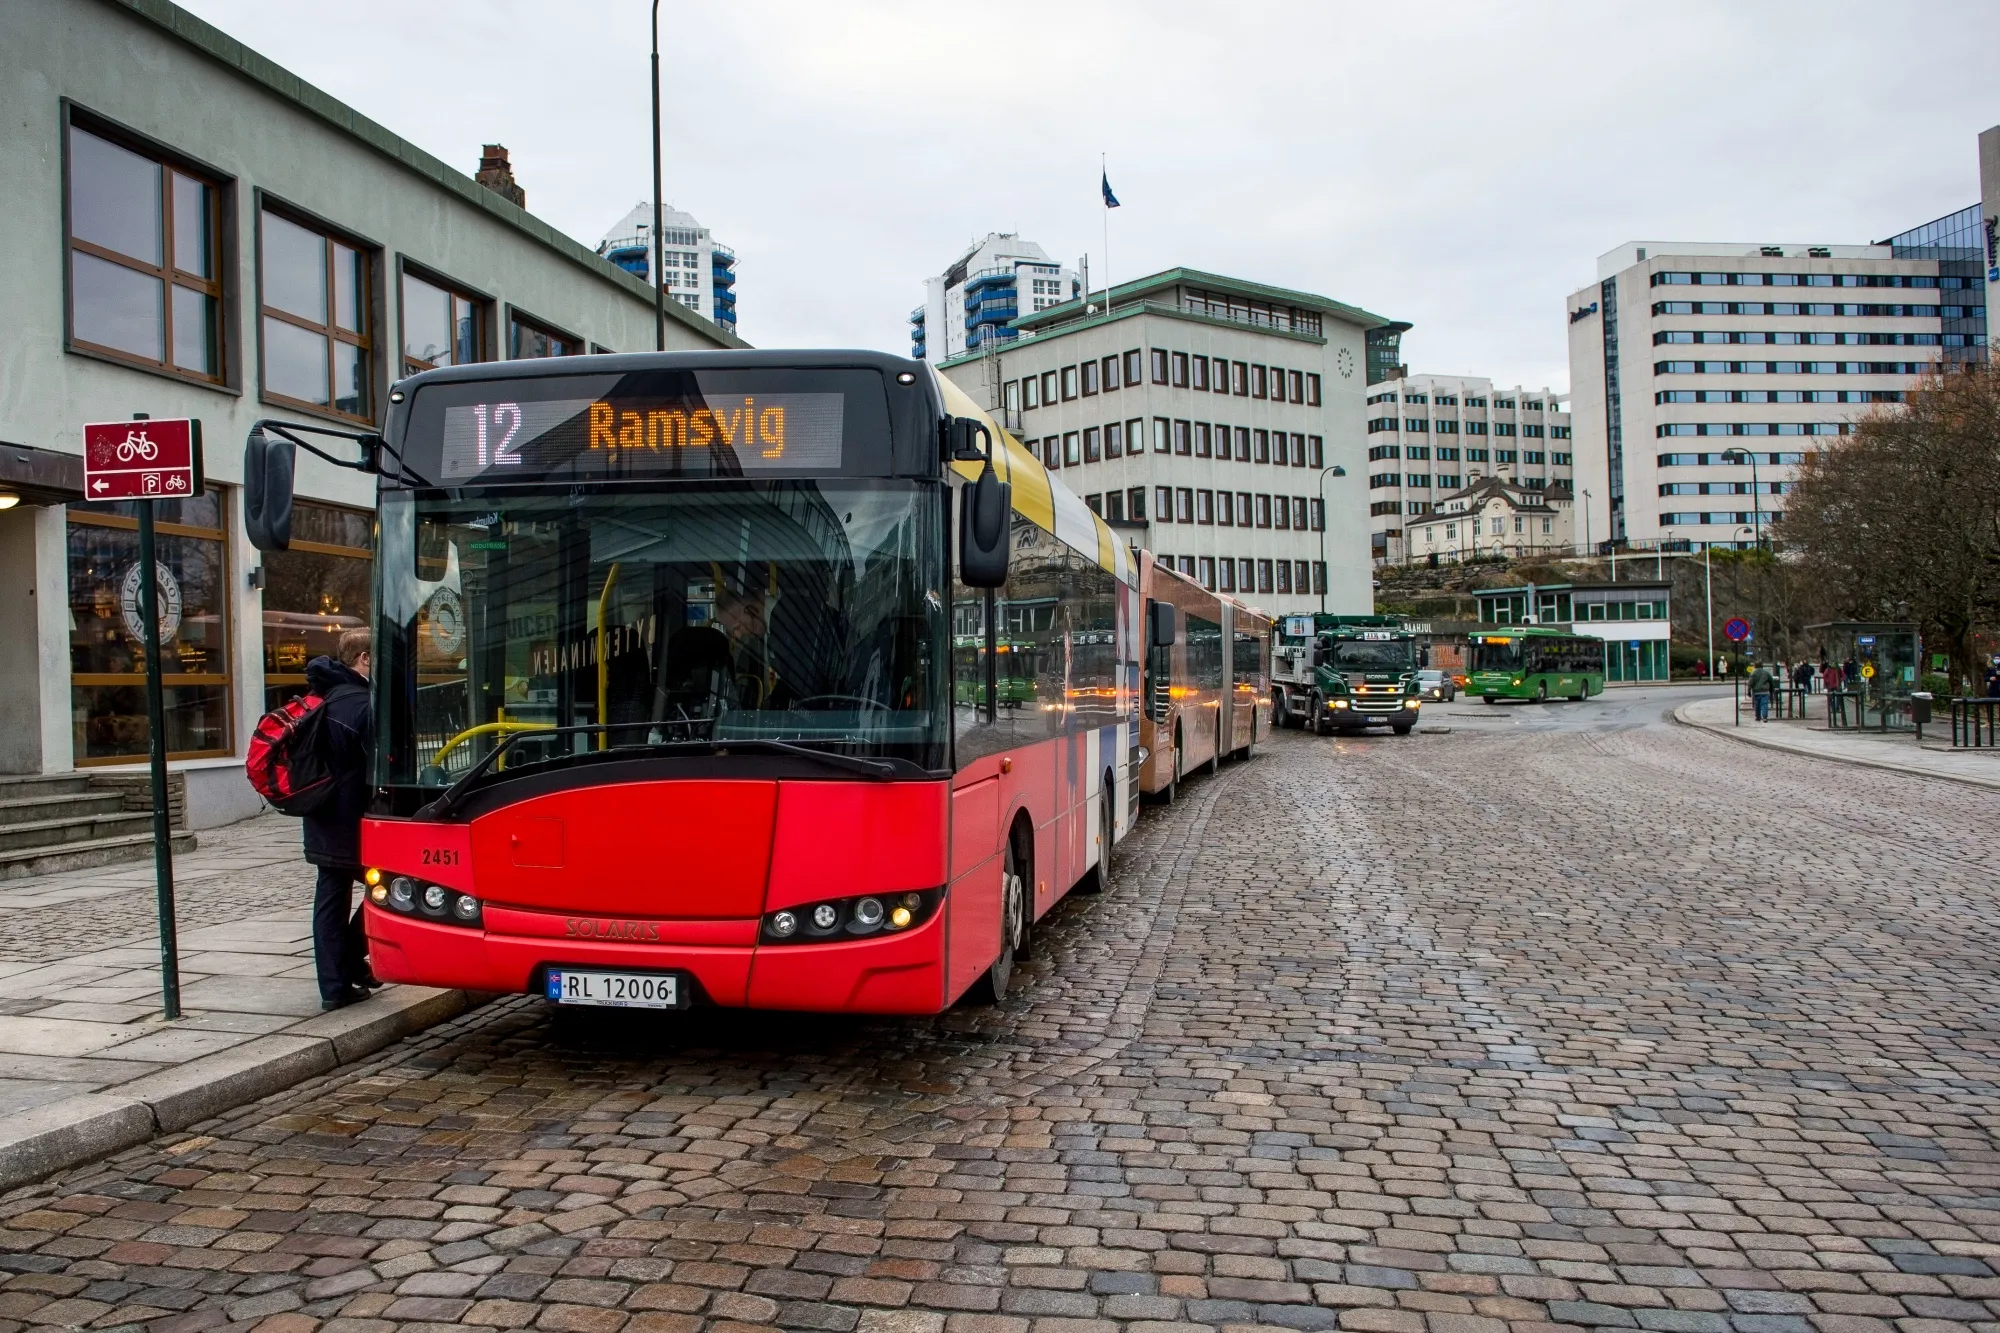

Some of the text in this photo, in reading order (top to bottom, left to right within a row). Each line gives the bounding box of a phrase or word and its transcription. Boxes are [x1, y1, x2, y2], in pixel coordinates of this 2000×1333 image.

[474, 397, 784, 465] 12 Ramsvig
[422, 850, 459, 866] 2451
[565, 919, 660, 941] SOLARIS
[568, 976, 668, 1000] RL 12006
